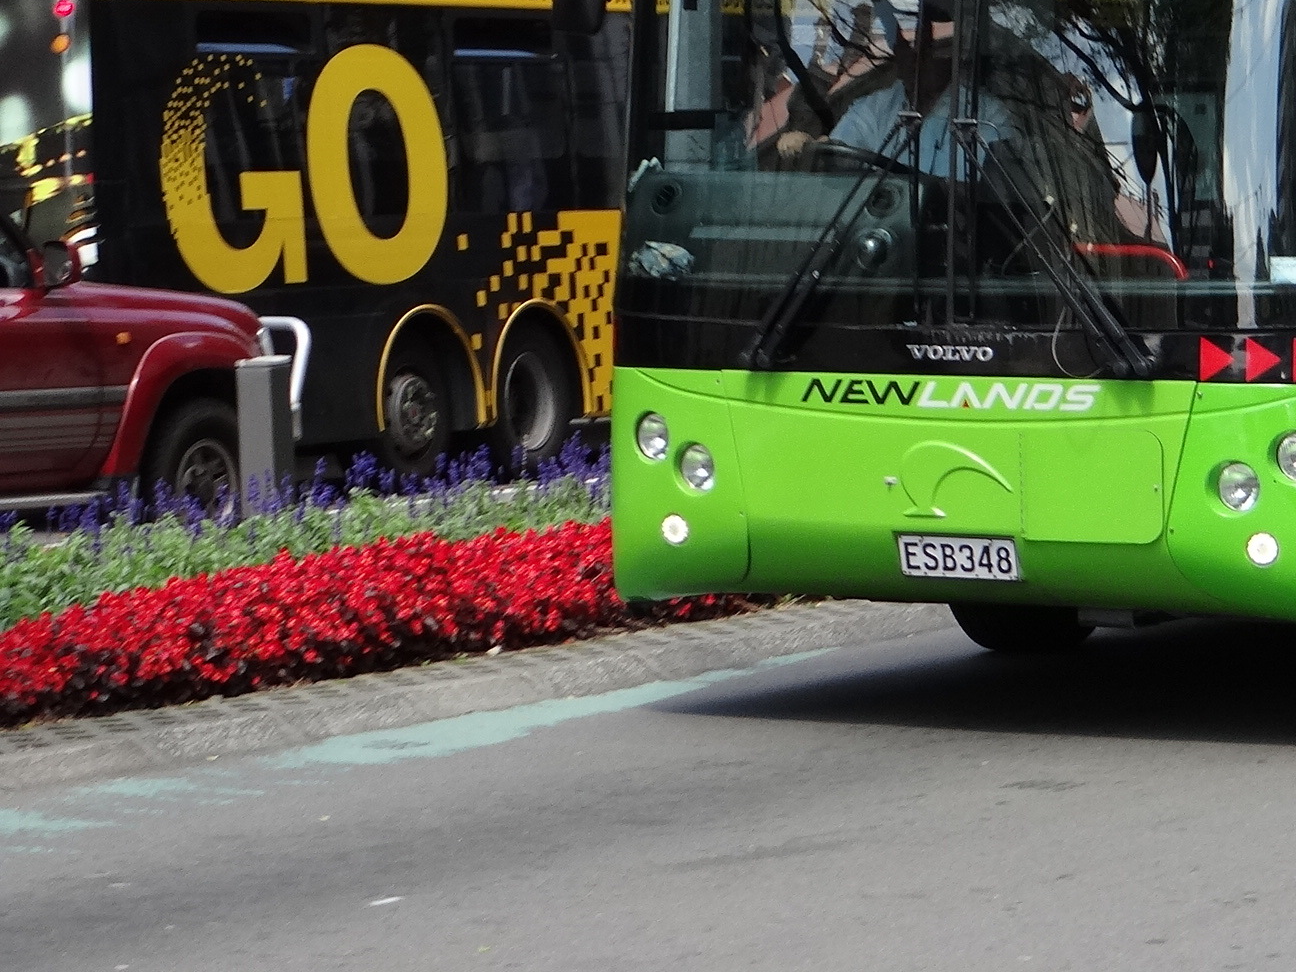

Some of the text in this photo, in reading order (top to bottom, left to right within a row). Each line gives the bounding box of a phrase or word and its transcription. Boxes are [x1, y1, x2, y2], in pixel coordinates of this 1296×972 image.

[160, 43, 448, 294] GO
[906, 343, 994, 362] VOLVO
[802, 378, 1102, 412] NEWLANDS
[903, 541, 1013, 574] ESB348
